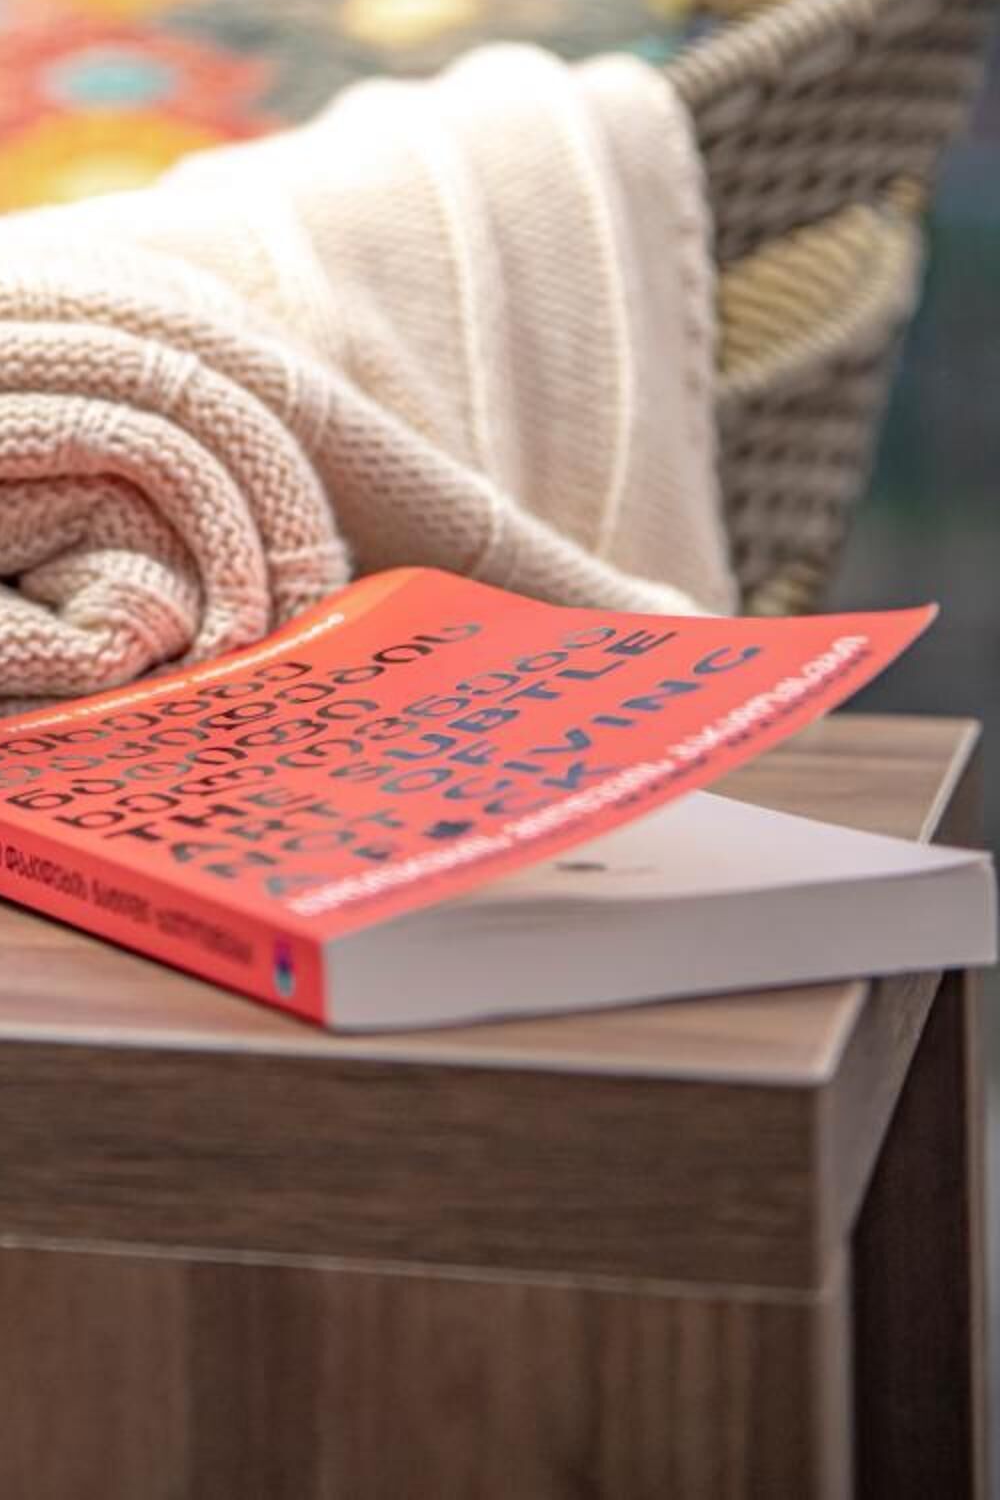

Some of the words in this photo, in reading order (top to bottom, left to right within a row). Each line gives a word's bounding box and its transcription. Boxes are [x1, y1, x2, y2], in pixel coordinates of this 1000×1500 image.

[104, 787, 316, 841] THE
[329, 630, 679, 782] SUBTLE
[381, 738, 500, 794] OF
[442, 646, 762, 799] GIVING
